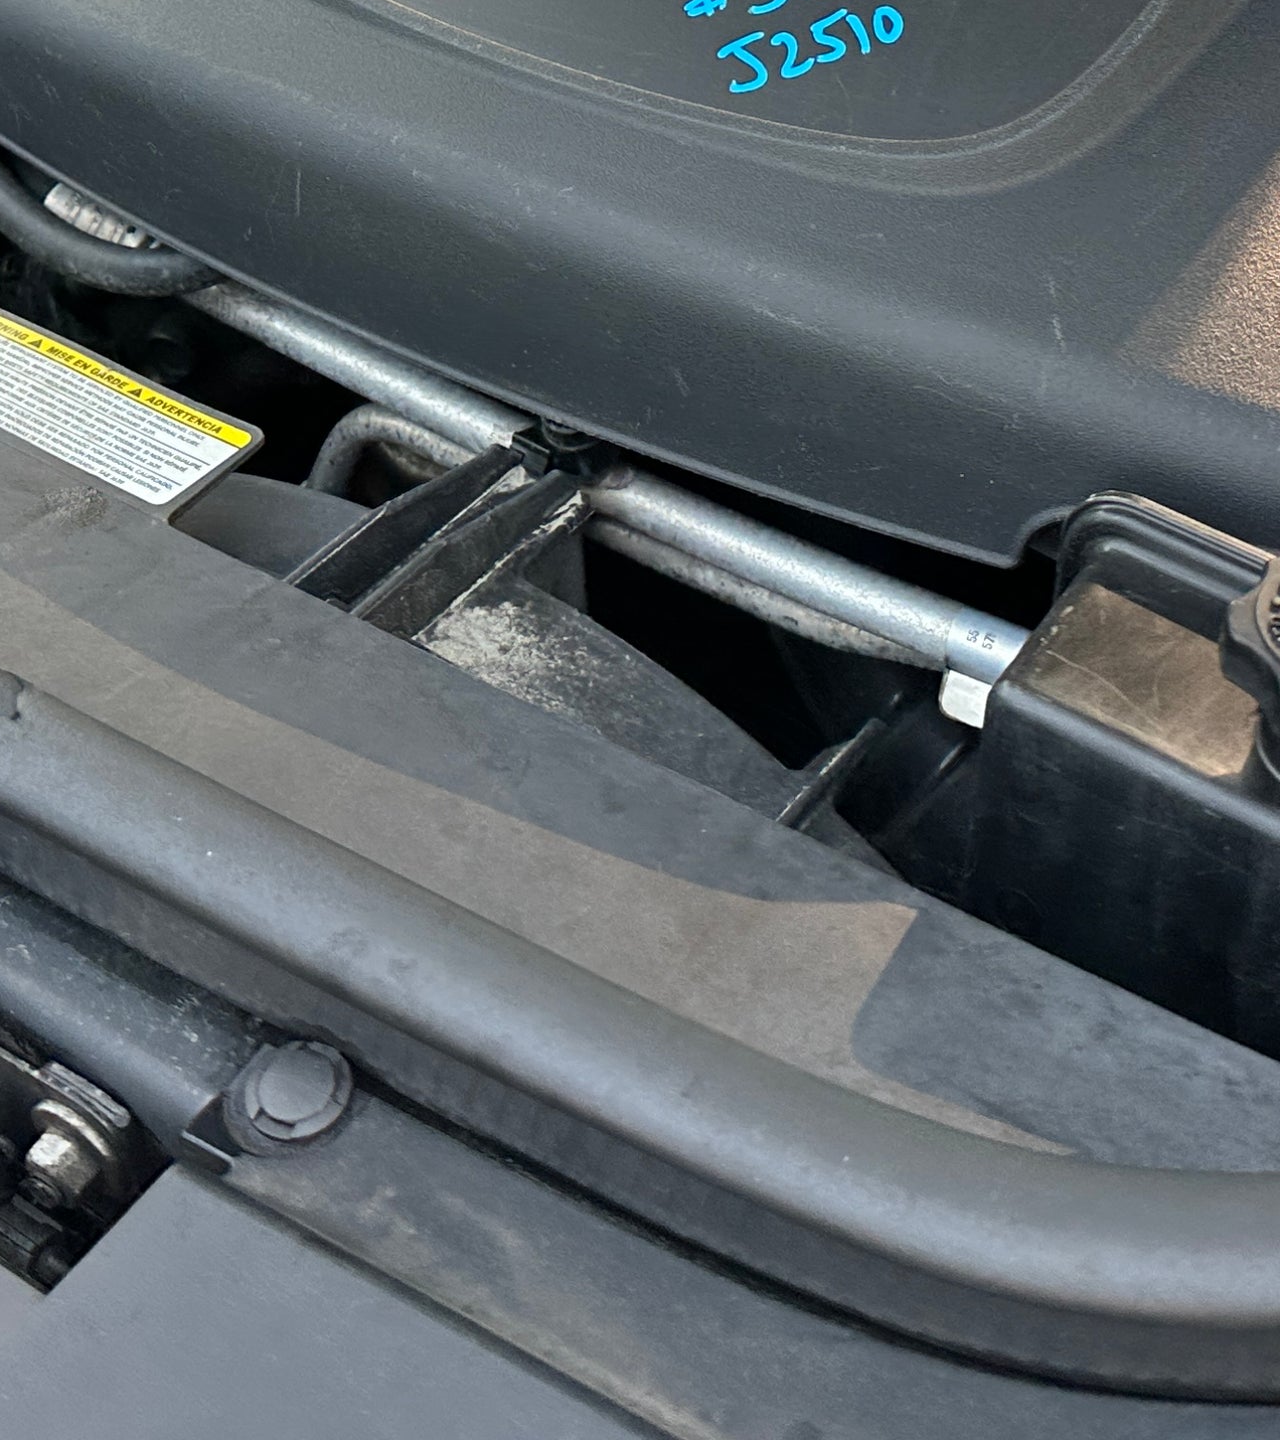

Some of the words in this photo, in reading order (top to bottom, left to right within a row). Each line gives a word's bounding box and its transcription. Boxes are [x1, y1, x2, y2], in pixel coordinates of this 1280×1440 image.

[46, 345, 73, 364] MISE
[73, 358, 92, 372] EN
[90, 365, 130, 391] GARDE
[144, 395, 223, 435] ADVERTENCIA
